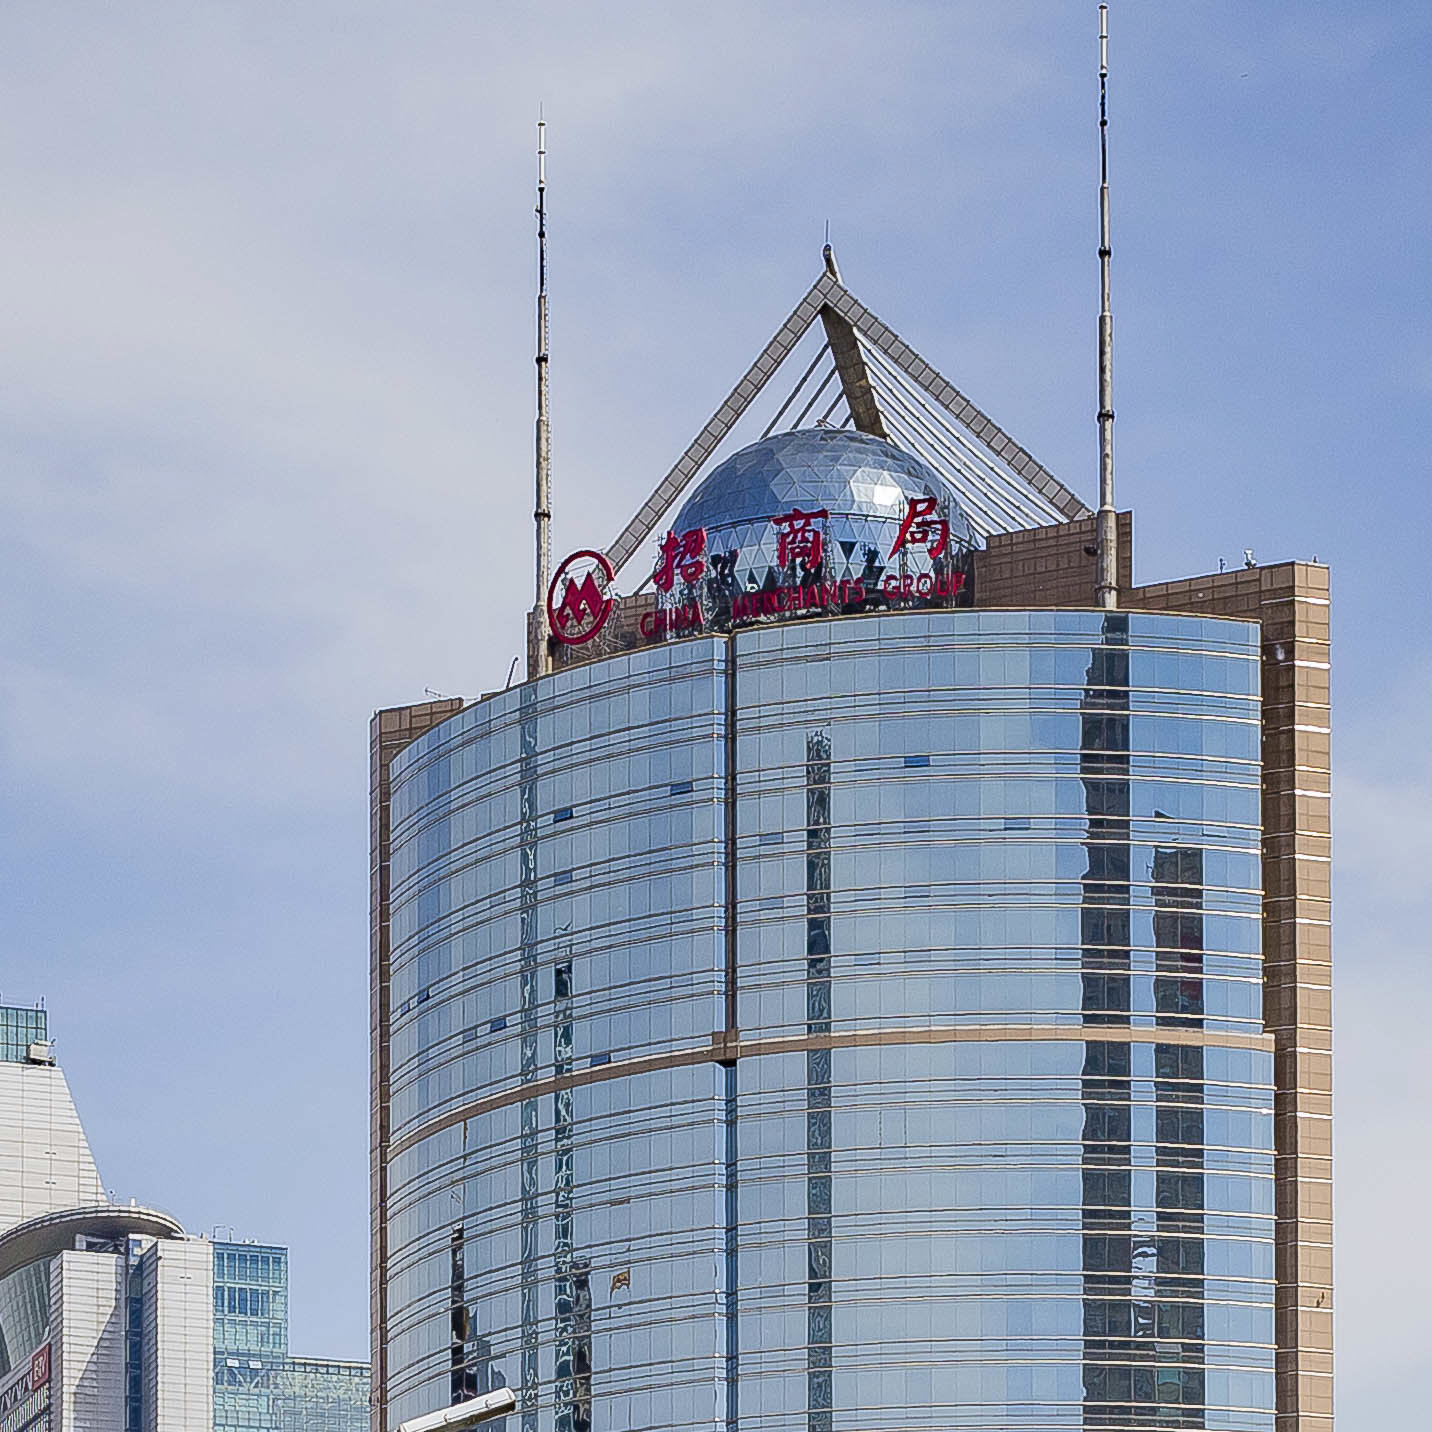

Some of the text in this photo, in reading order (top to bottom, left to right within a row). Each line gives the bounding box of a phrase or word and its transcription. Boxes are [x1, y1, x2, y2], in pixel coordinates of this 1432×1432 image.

[652, 496, 951, 592] 招商局
[639, 571, 967, 639] CHINA MERCHANTS GROUP
